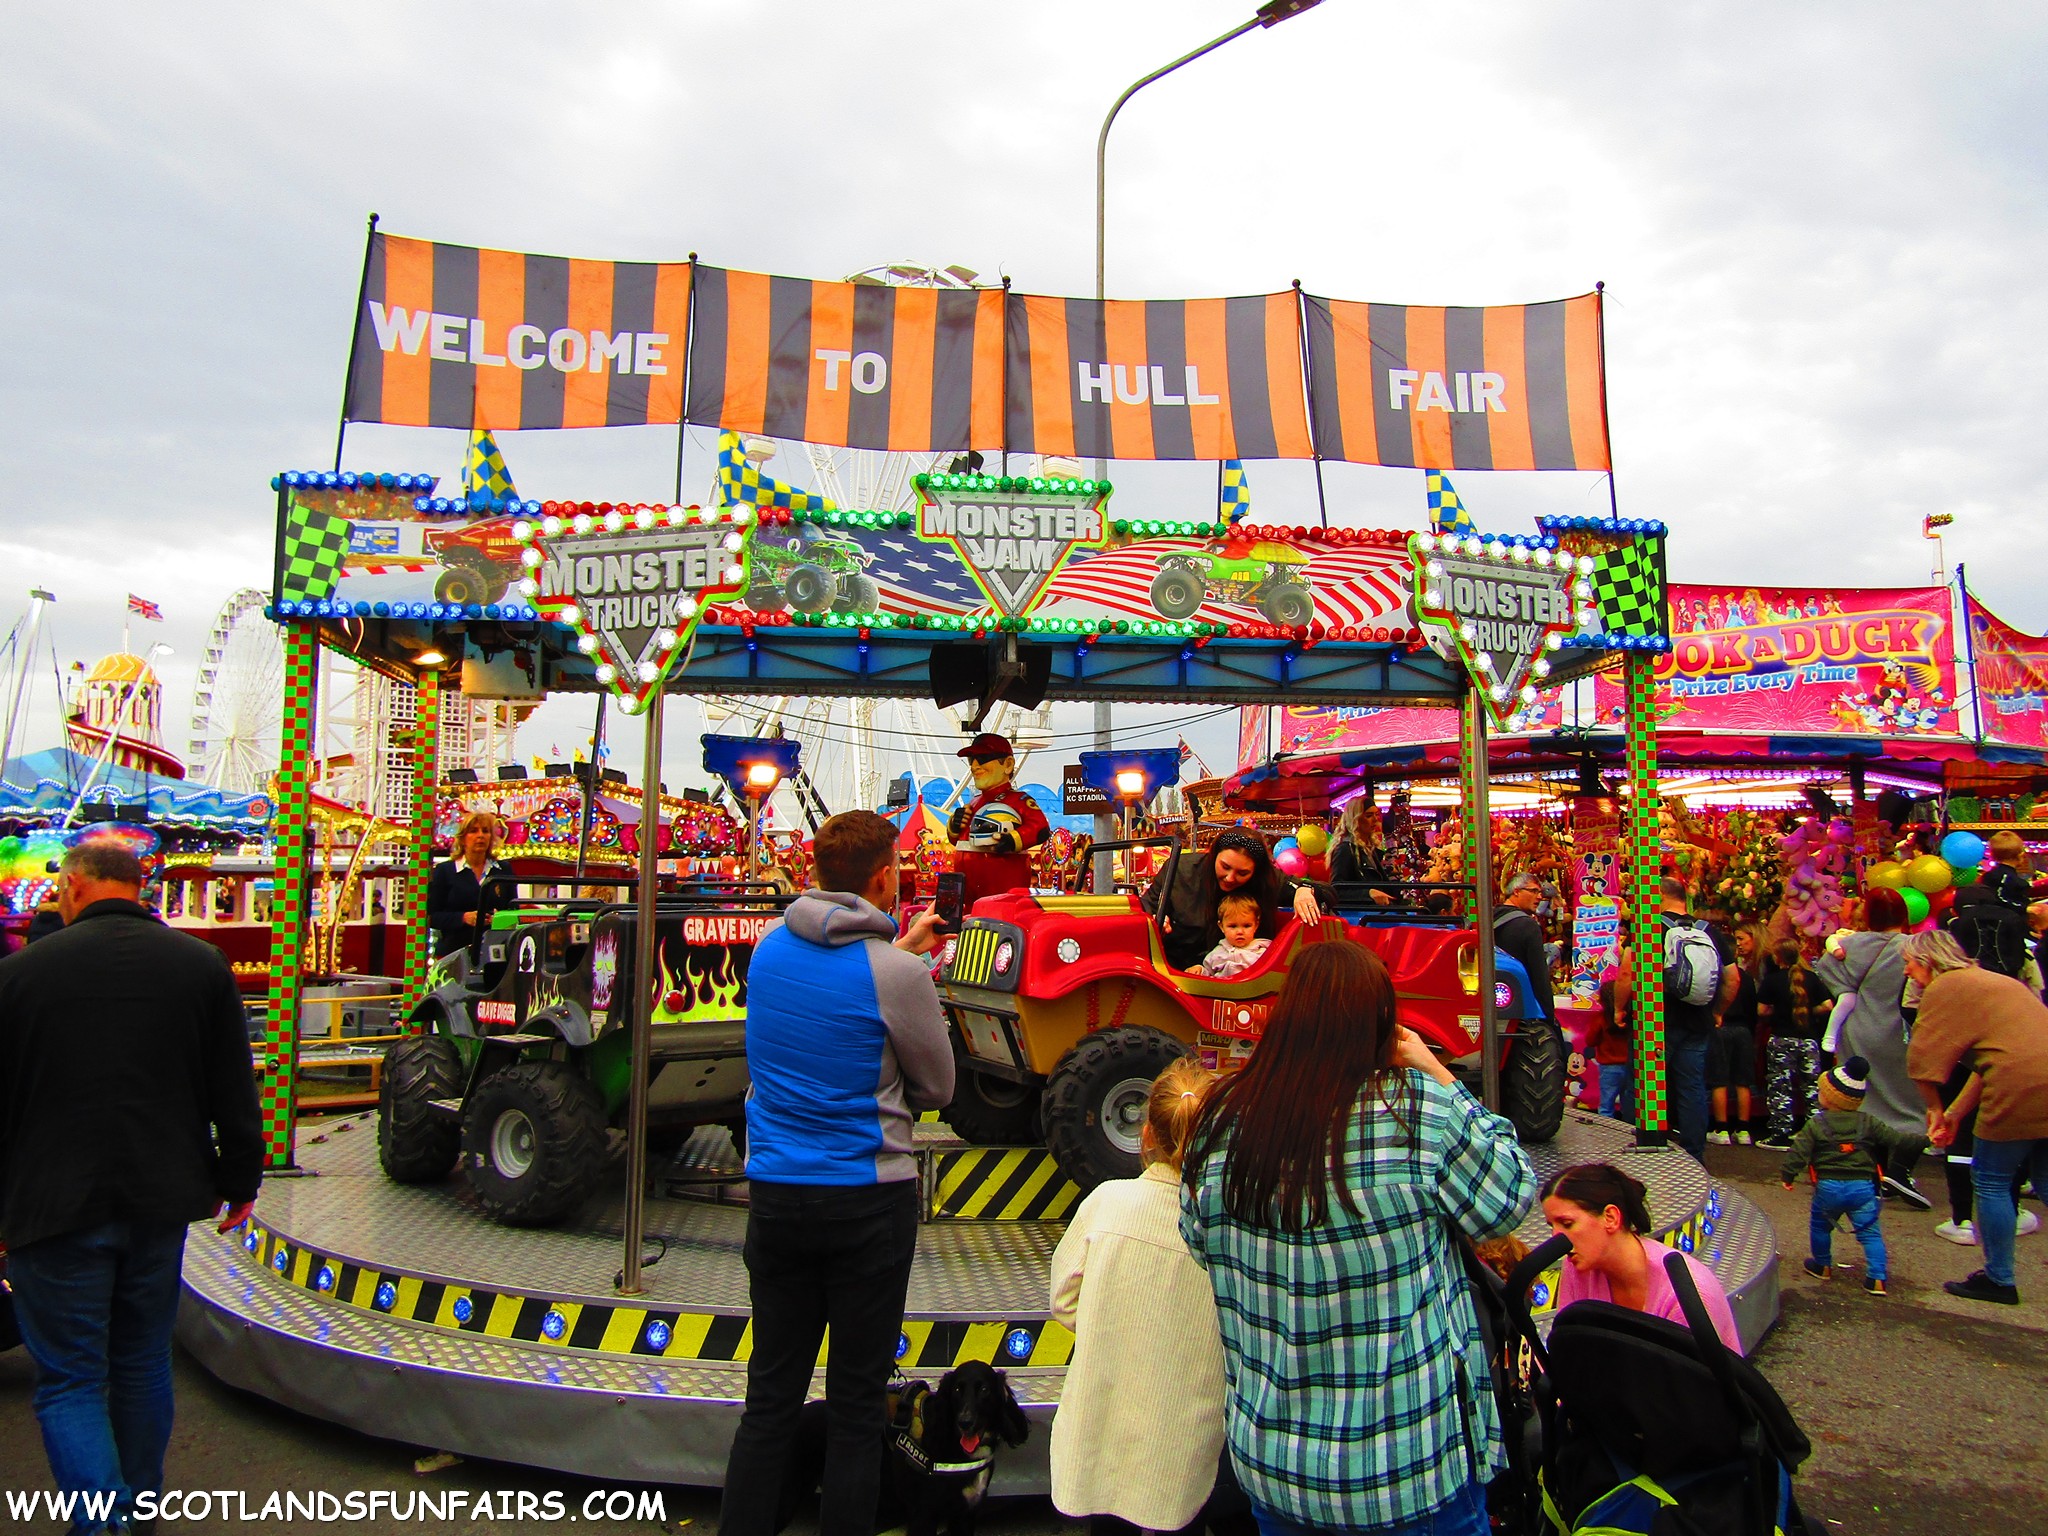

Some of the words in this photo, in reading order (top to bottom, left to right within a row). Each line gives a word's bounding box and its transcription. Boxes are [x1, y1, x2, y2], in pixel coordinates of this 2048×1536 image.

[368, 300, 669, 375] WELCOME
[815, 350, 887, 394] TO
[1079, 361, 1220, 405] HULL
[1388, 369, 1506, 412] FAIR
[924, 503, 1102, 541] MONSTER
[541, 547, 743, 597] MONSTER
[971, 538, 1054, 572] JAM
[587, 594, 678, 631] TRUCK
[1753, 636, 1776, 659] A
[1781, 617, 1921, 661] DUCK
[1672, 677, 1728, 697] Prize
[1732, 671, 1795, 693] Every
[1802, 662, 1857, 685] Time
[1574, 920, 1619, 934] Every
[1577, 906, 1616, 919] Prize
[684, 918, 737, 943] GRAVE
[1578, 936, 1615, 949] Time
[479, 1001, 497, 1020] GRAVE
[497, 1003, 516, 1022] DIGGER
[1212, 999, 1267, 1034] IRON
[900, 1436, 930, 1463] Jasper
